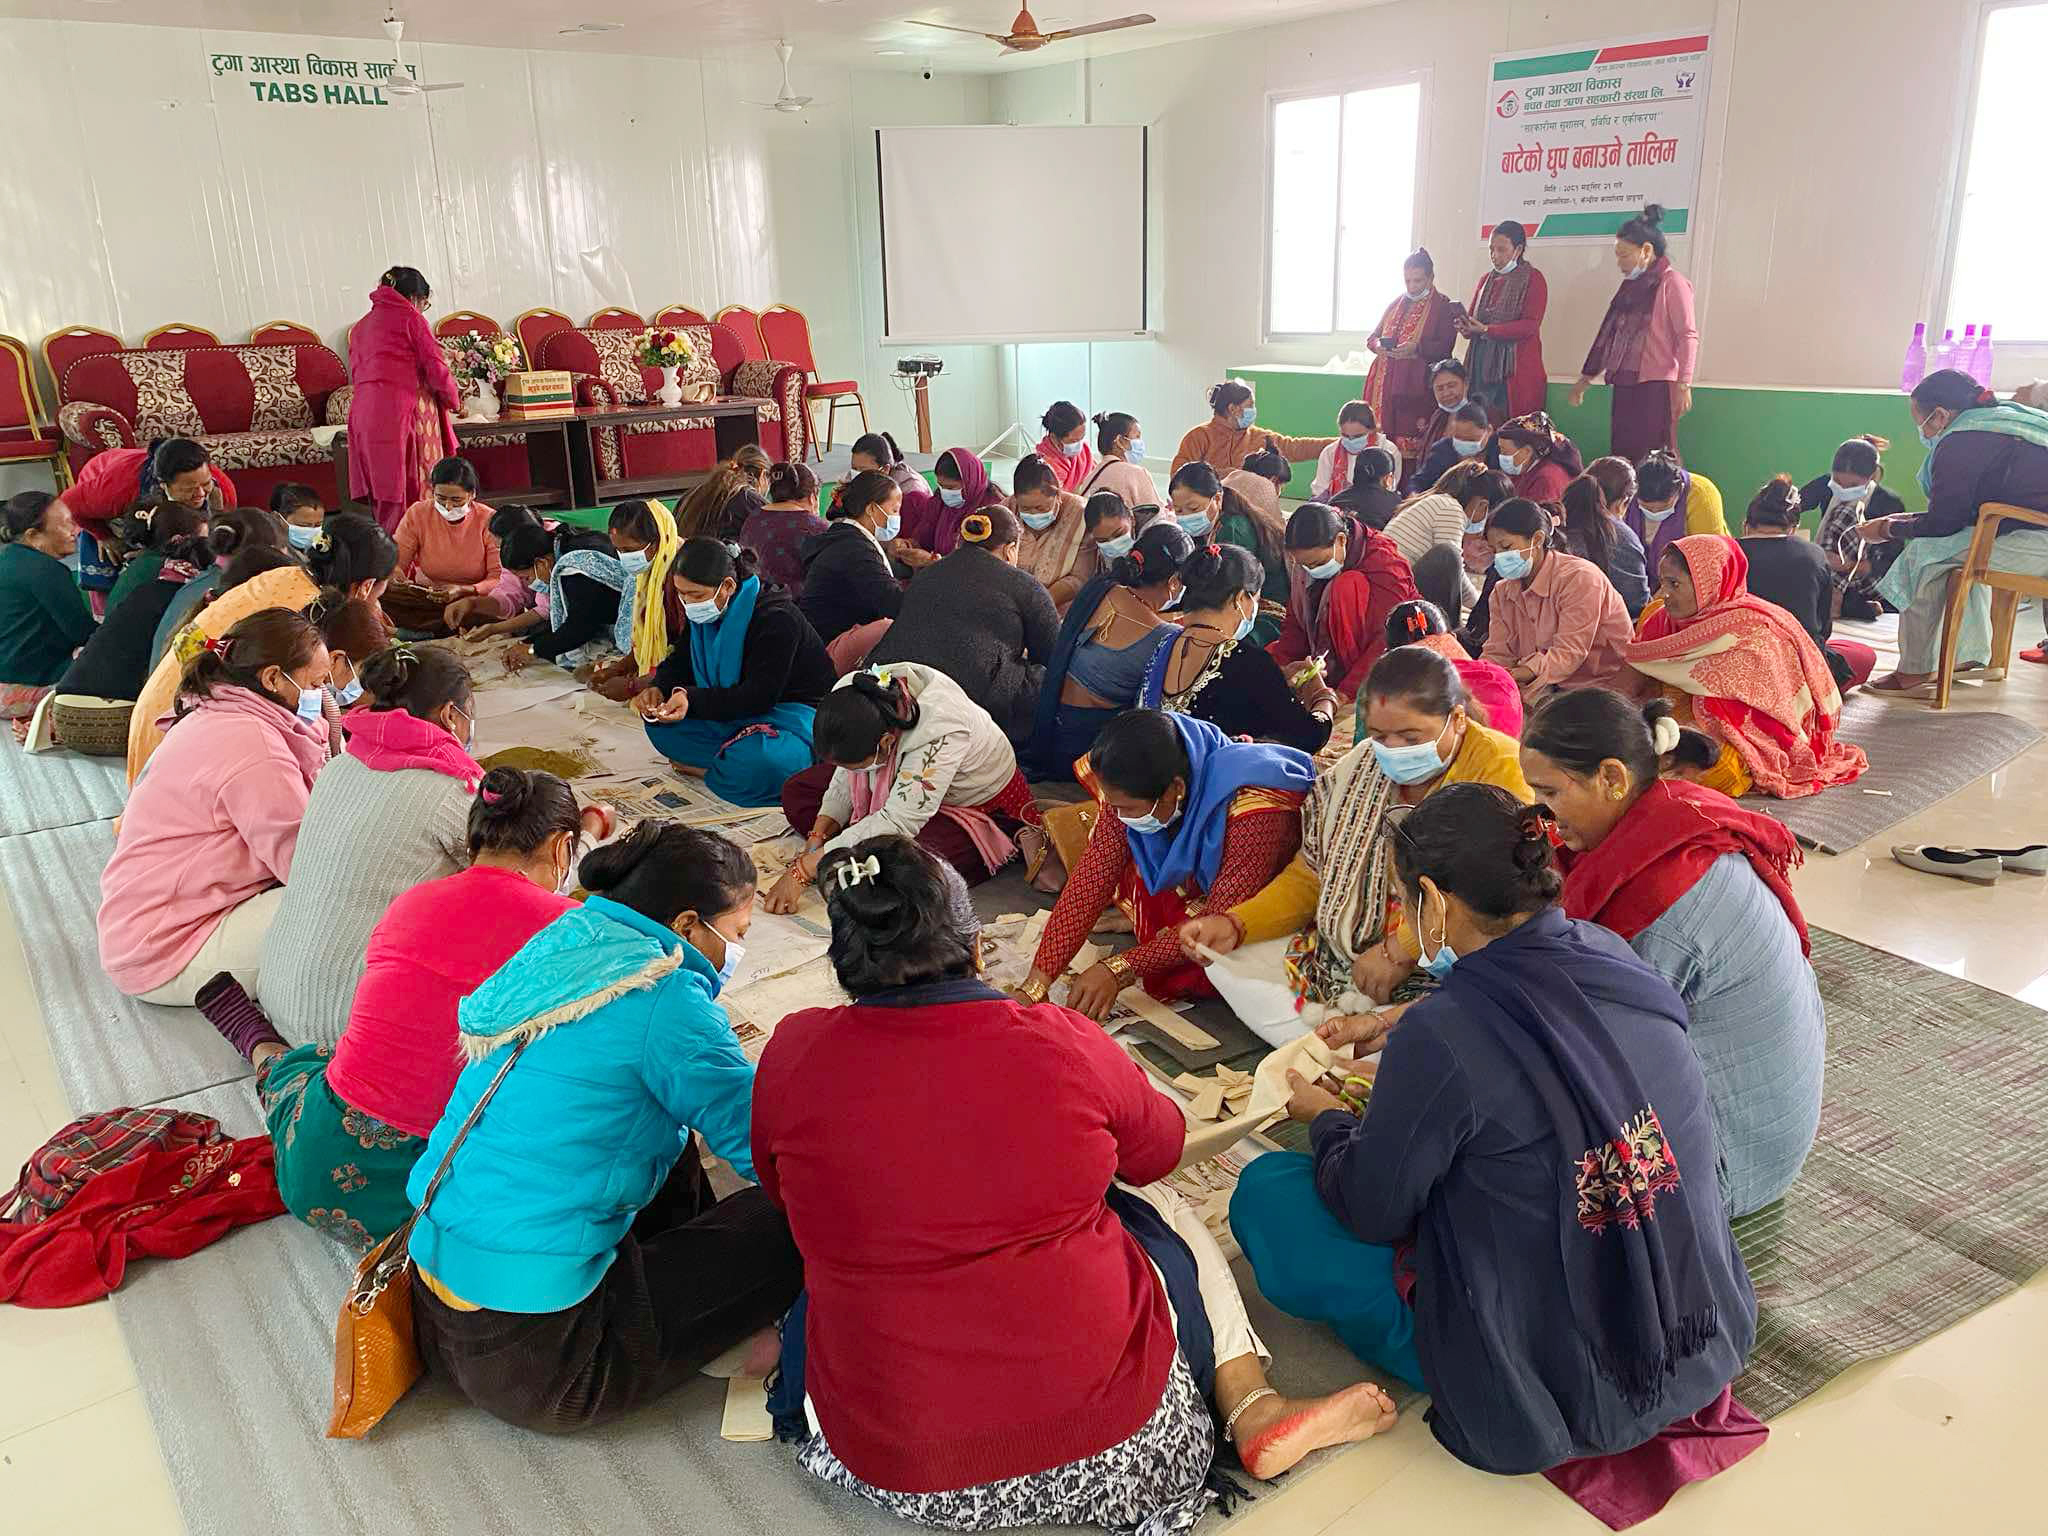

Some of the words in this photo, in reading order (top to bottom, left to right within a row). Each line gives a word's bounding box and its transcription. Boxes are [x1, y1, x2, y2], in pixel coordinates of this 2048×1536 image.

[210, 53, 243, 76] टुगा
[248, 56, 300, 76] आस्था
[306, 53, 358, 79] विकास
[250, 81, 318, 104] TABS
[324, 84, 389, 106] HALL
[1524, 86, 1545, 101] टुगा
[1548, 81, 1583, 95] आस्था
[1585, 77, 1622, 91] विकास
[1524, 101, 1542, 111] बचत
[1544, 98, 1561, 109] तथा
[1586, 91, 1620, 105] सहकारी
[1623, 89, 1648, 100] संस्था
[1614, 115, 1620, 125] र
[1502, 142, 1544, 173] बाटेको
[1572, 136, 1622, 169] बनाउने
[1626, 131, 1679, 167] तालिम
